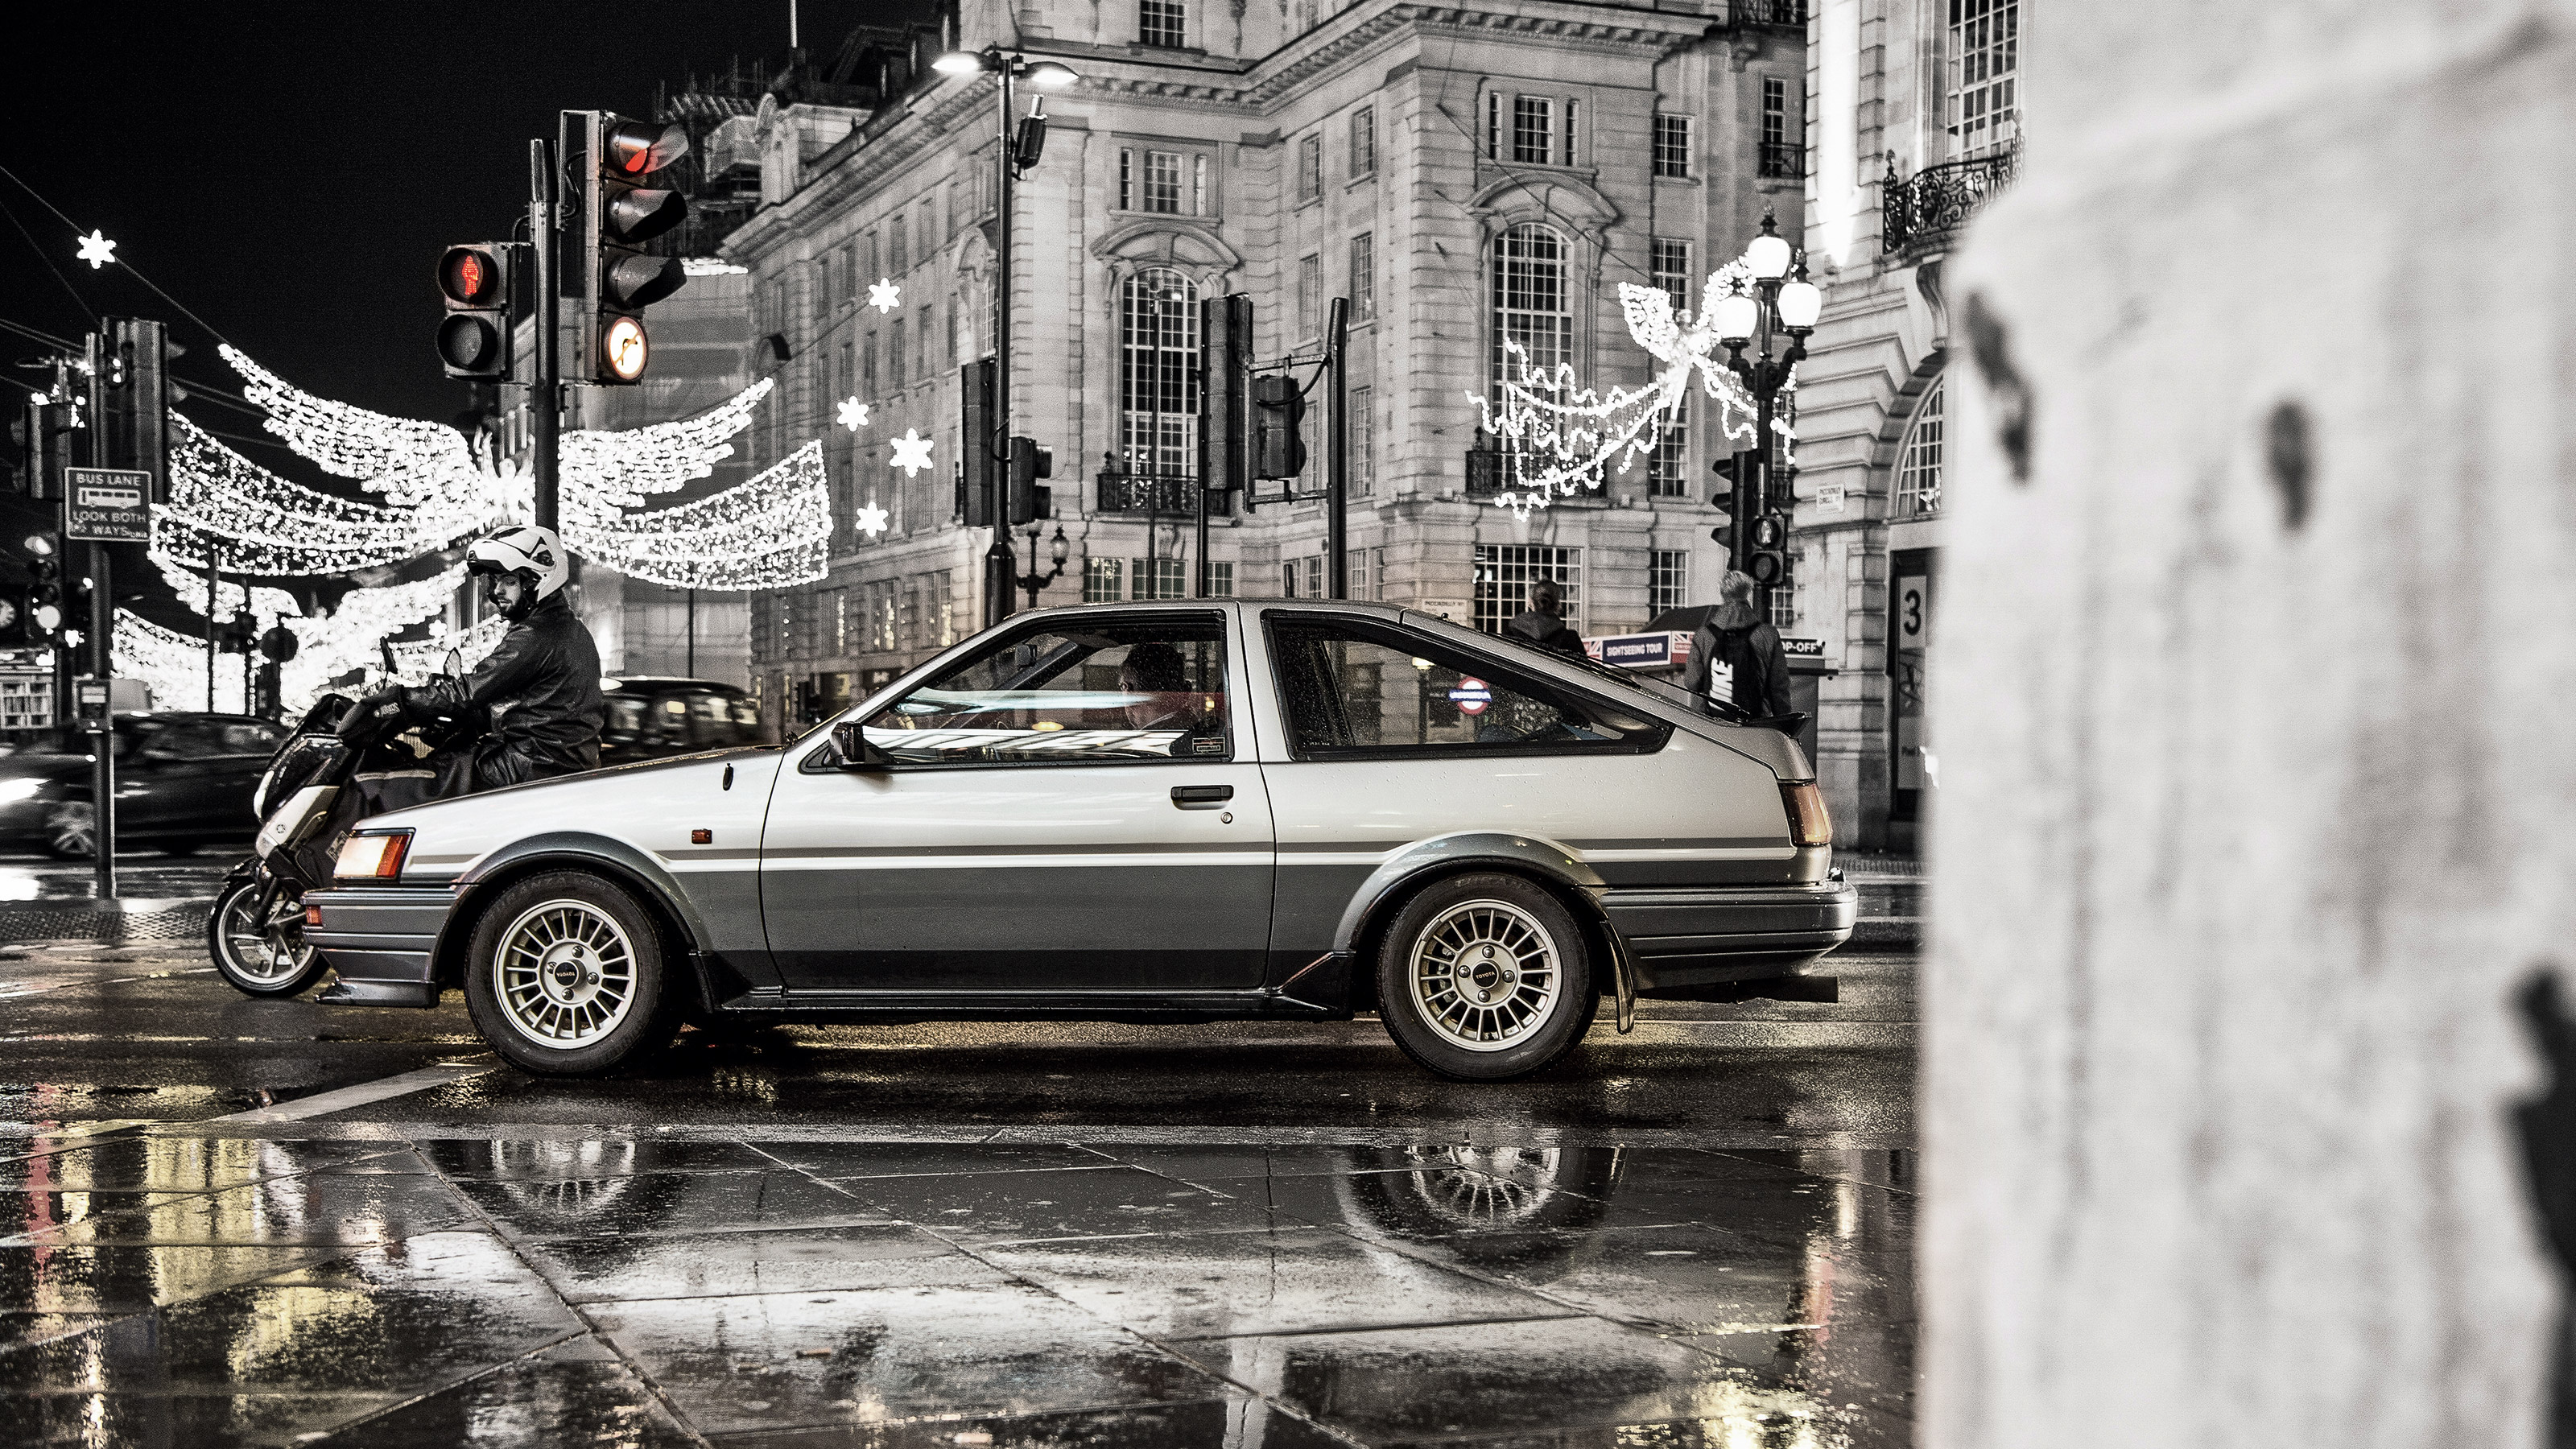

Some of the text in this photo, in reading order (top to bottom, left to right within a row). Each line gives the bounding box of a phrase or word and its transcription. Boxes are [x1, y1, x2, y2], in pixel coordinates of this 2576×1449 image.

[76, 473, 141, 486] BUS LANE
[72, 510, 147, 523] LOOK BOTH
[92, 524, 130, 537] WAYS
[1903, 588, 1922, 636] 3
[1607, 642, 1662, 657] SIGHTSEEING TOUR
[1476, 971, 1496, 980] TOYOTA
